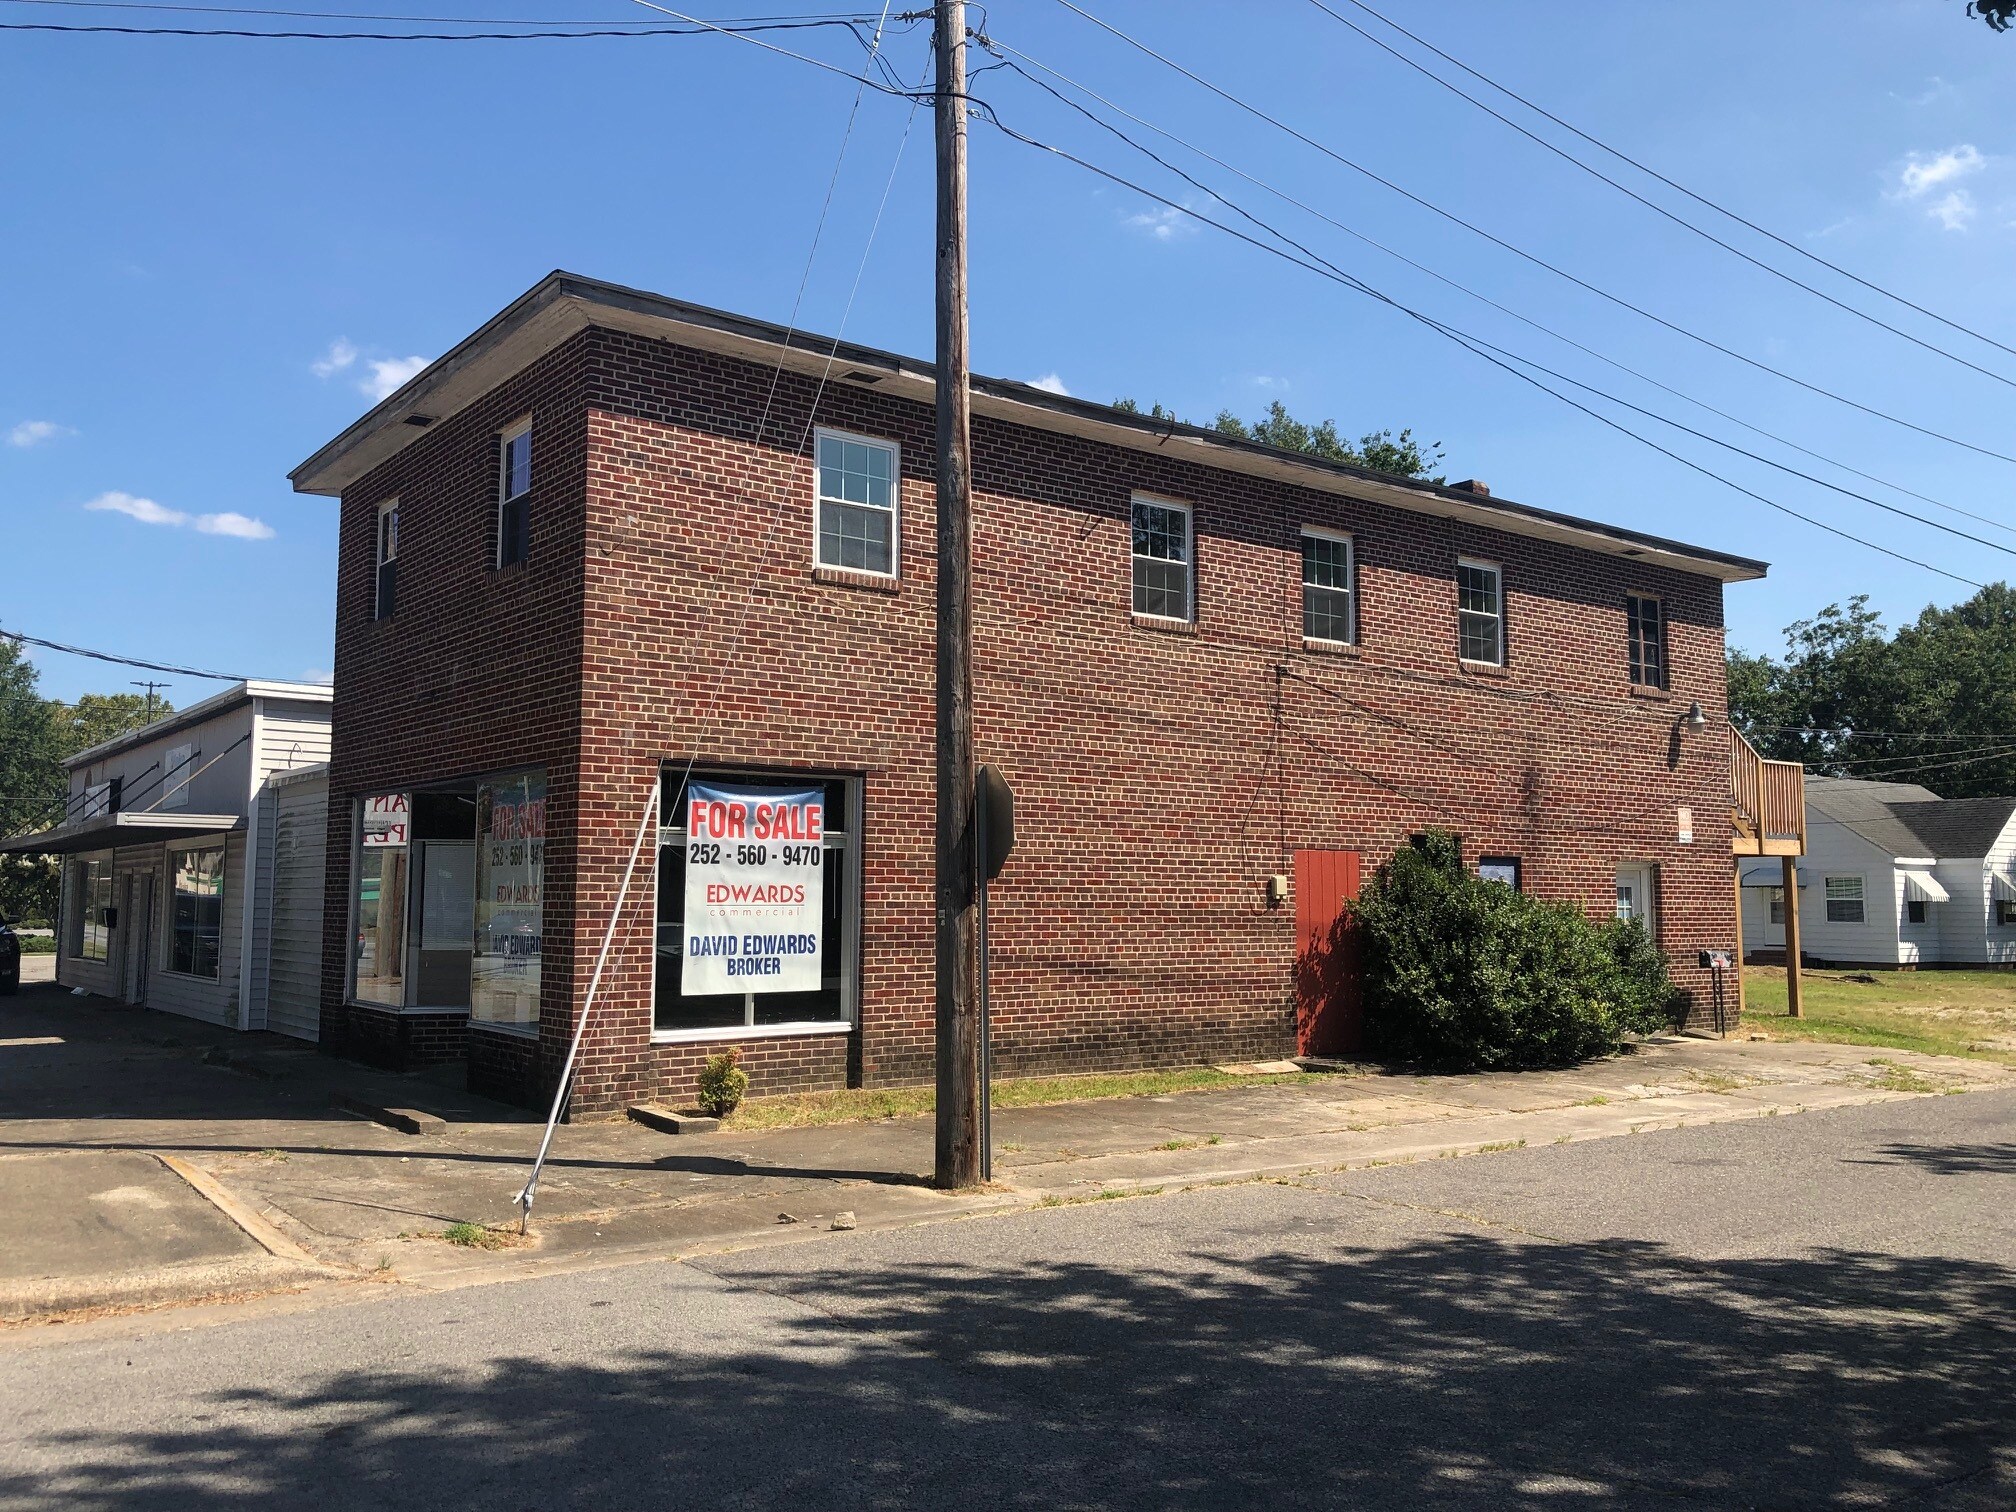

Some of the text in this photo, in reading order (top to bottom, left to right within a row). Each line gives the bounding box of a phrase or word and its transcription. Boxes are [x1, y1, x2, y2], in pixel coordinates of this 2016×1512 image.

[492, 804, 515, 841] FOR
[690, 801, 820, 840] FOR SALE
[690, 843, 721, 865] 252
[737, 844, 767, 866] 560
[782, 845, 820, 867] 9470
[707, 884, 805, 904] EDWARDS
[709, 907, 801, 917] commercial
[689, 933, 817, 957] DAVID EDWARDS
[727, 957, 781, 976] BROKER
